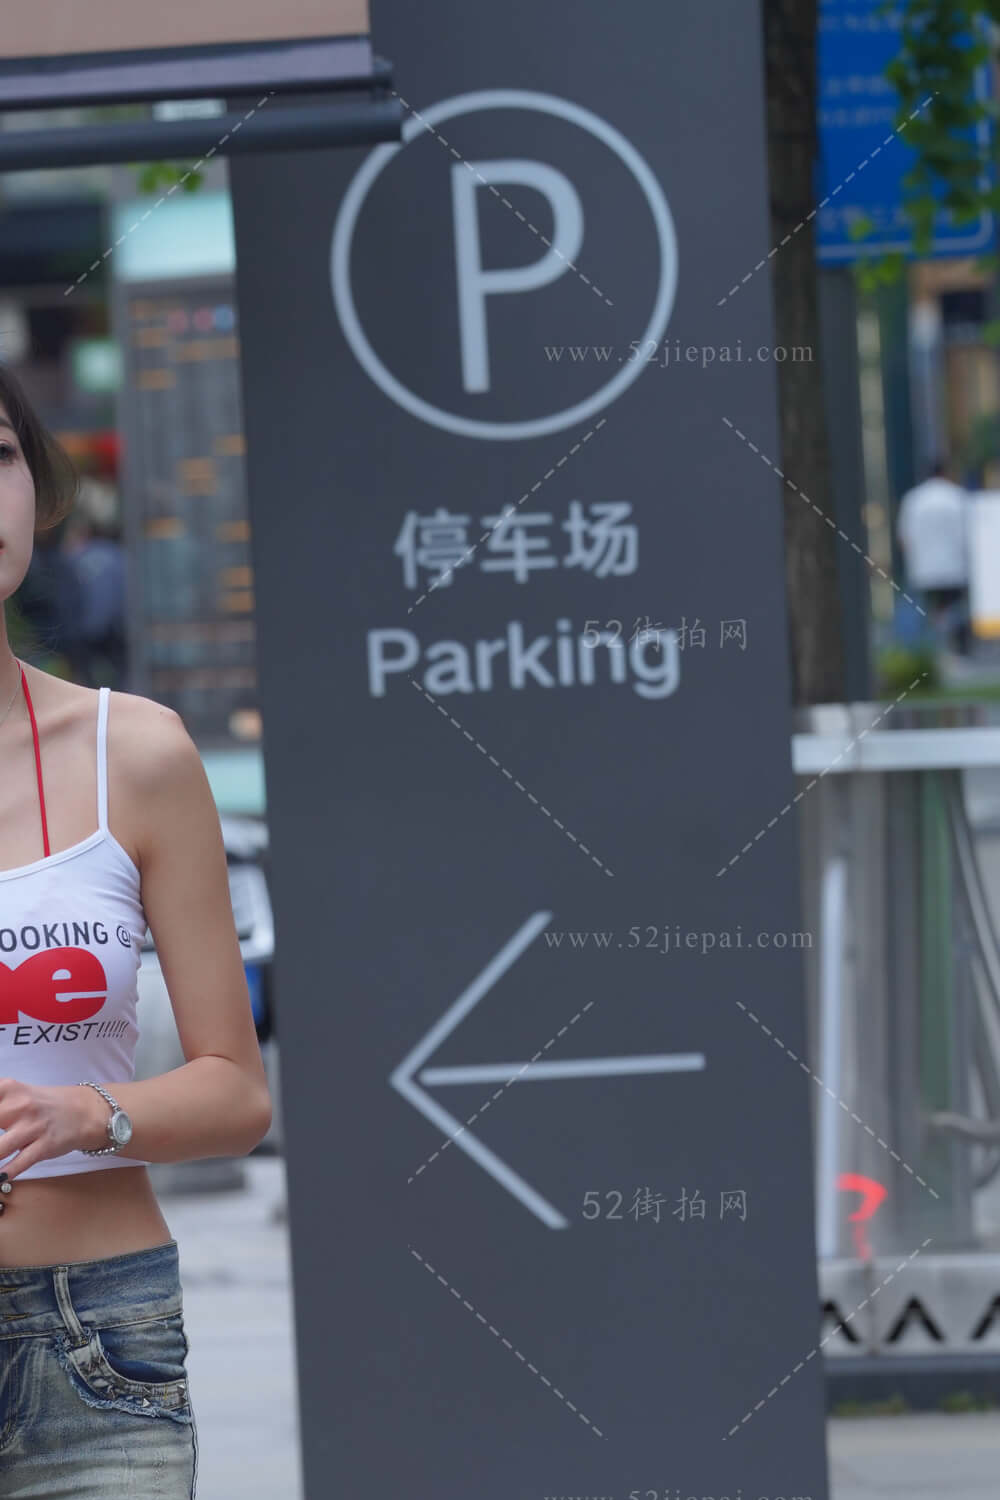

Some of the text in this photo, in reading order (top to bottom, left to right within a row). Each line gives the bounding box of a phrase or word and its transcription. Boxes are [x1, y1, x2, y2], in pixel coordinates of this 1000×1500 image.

[451, 157, 584, 395] P
[394, 499, 640, 590] 停车场
[366, 618, 682, 699] Parking
